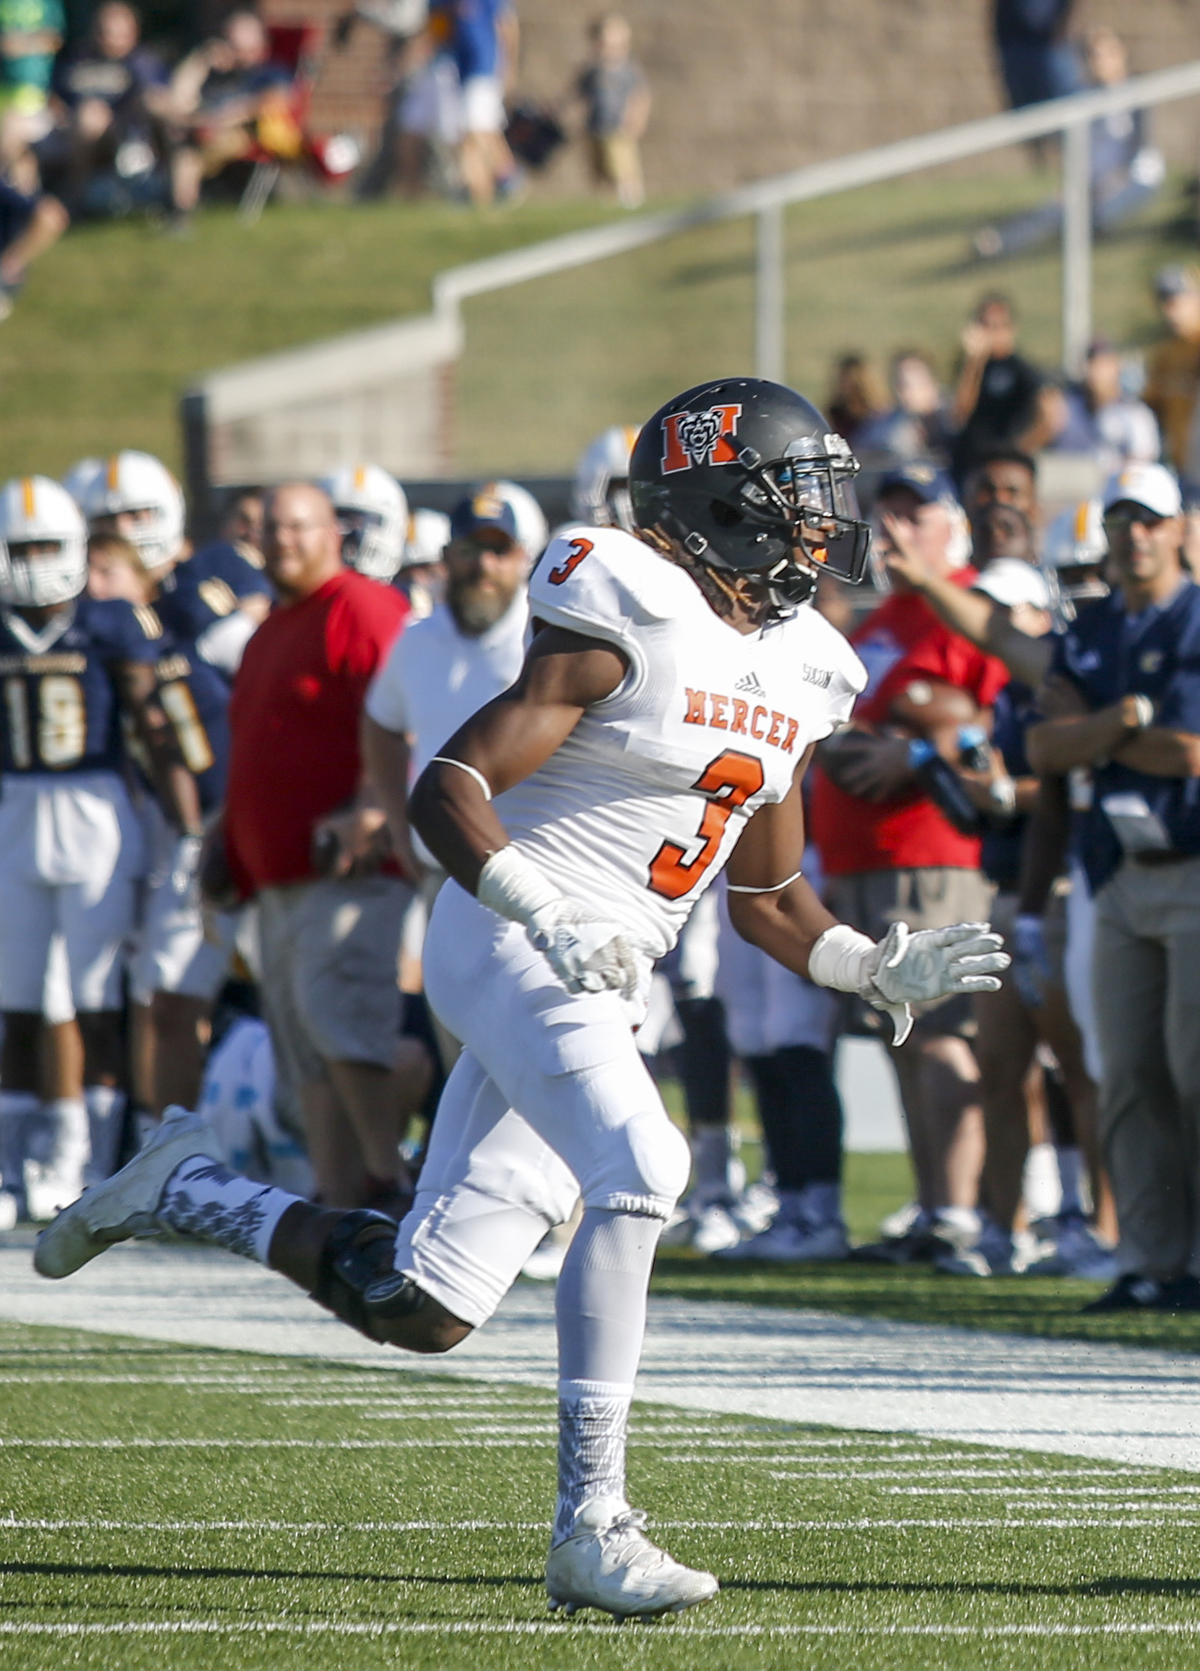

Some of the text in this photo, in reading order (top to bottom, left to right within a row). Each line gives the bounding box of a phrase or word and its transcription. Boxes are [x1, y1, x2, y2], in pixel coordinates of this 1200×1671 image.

[547, 537, 594, 586] 3
[682, 687, 799, 755] MERCER
[647, 747, 764, 901] 3
